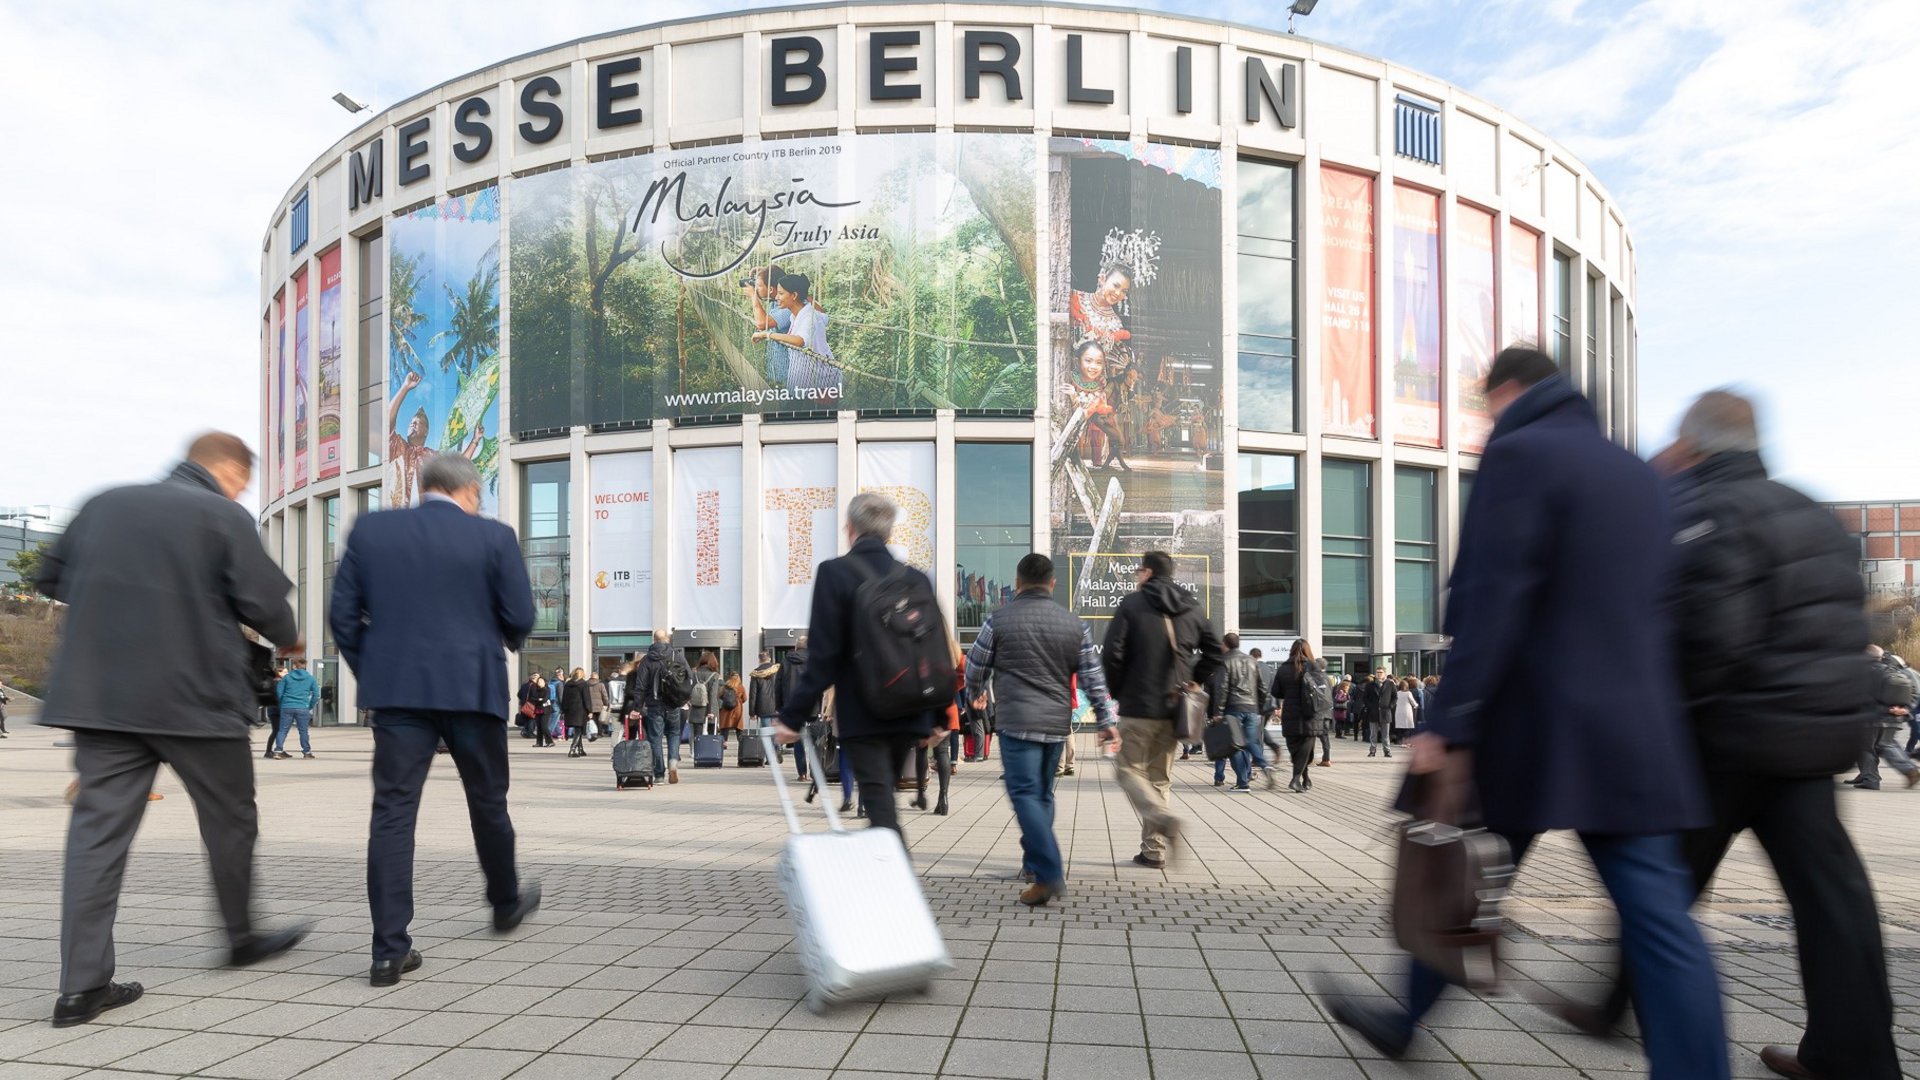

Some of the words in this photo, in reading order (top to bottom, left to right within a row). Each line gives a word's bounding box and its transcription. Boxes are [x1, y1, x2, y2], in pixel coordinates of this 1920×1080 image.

[348, 56, 643, 210] MESSE
[771, 30, 1297, 129] BERLIN
[663, 158, 696, 169] Official
[697, 154, 731, 166] Partner
[732, 150, 769, 164] Country
[771, 149, 786, 158] ITB
[789, 147, 816, 157] Berlin
[818, 145, 842, 155] 2019
[632, 171, 861, 278] Malaysia
[773, 220, 832, 247] Truly
[837, 224, 880, 241] Asia
[664, 383, 844, 407] www.malaysia.travel
[595, 492, 650, 504] WELCOME
[595, 510, 609, 520] TO
[613, 571, 631, 581] ITB
[1081, 596, 1106, 607] Hall
[690, 630, 697, 639] C
[787, 628, 795, 638] C
